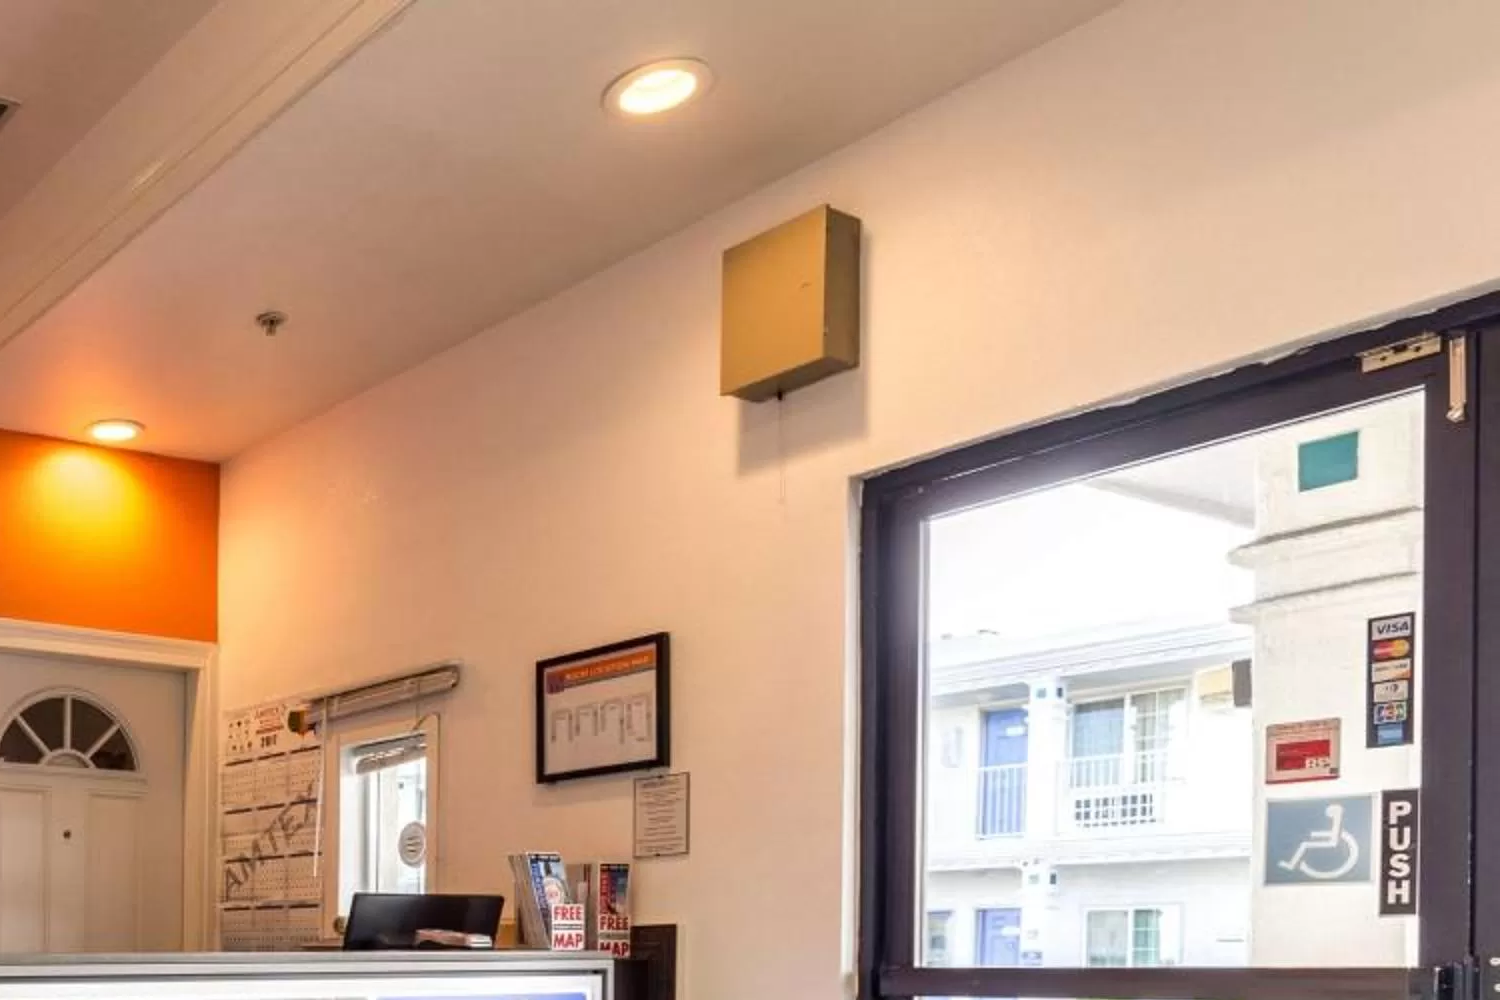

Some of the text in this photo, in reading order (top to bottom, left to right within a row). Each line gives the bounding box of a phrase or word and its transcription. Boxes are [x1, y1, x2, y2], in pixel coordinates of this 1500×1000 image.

[1377, 621, 1409, 635] VISA
[1387, 801, 1412, 904] PUSH
[553, 905, 583, 921] FREE
[599, 916, 629, 931] FREE
[553, 933, 583, 948] MAP
